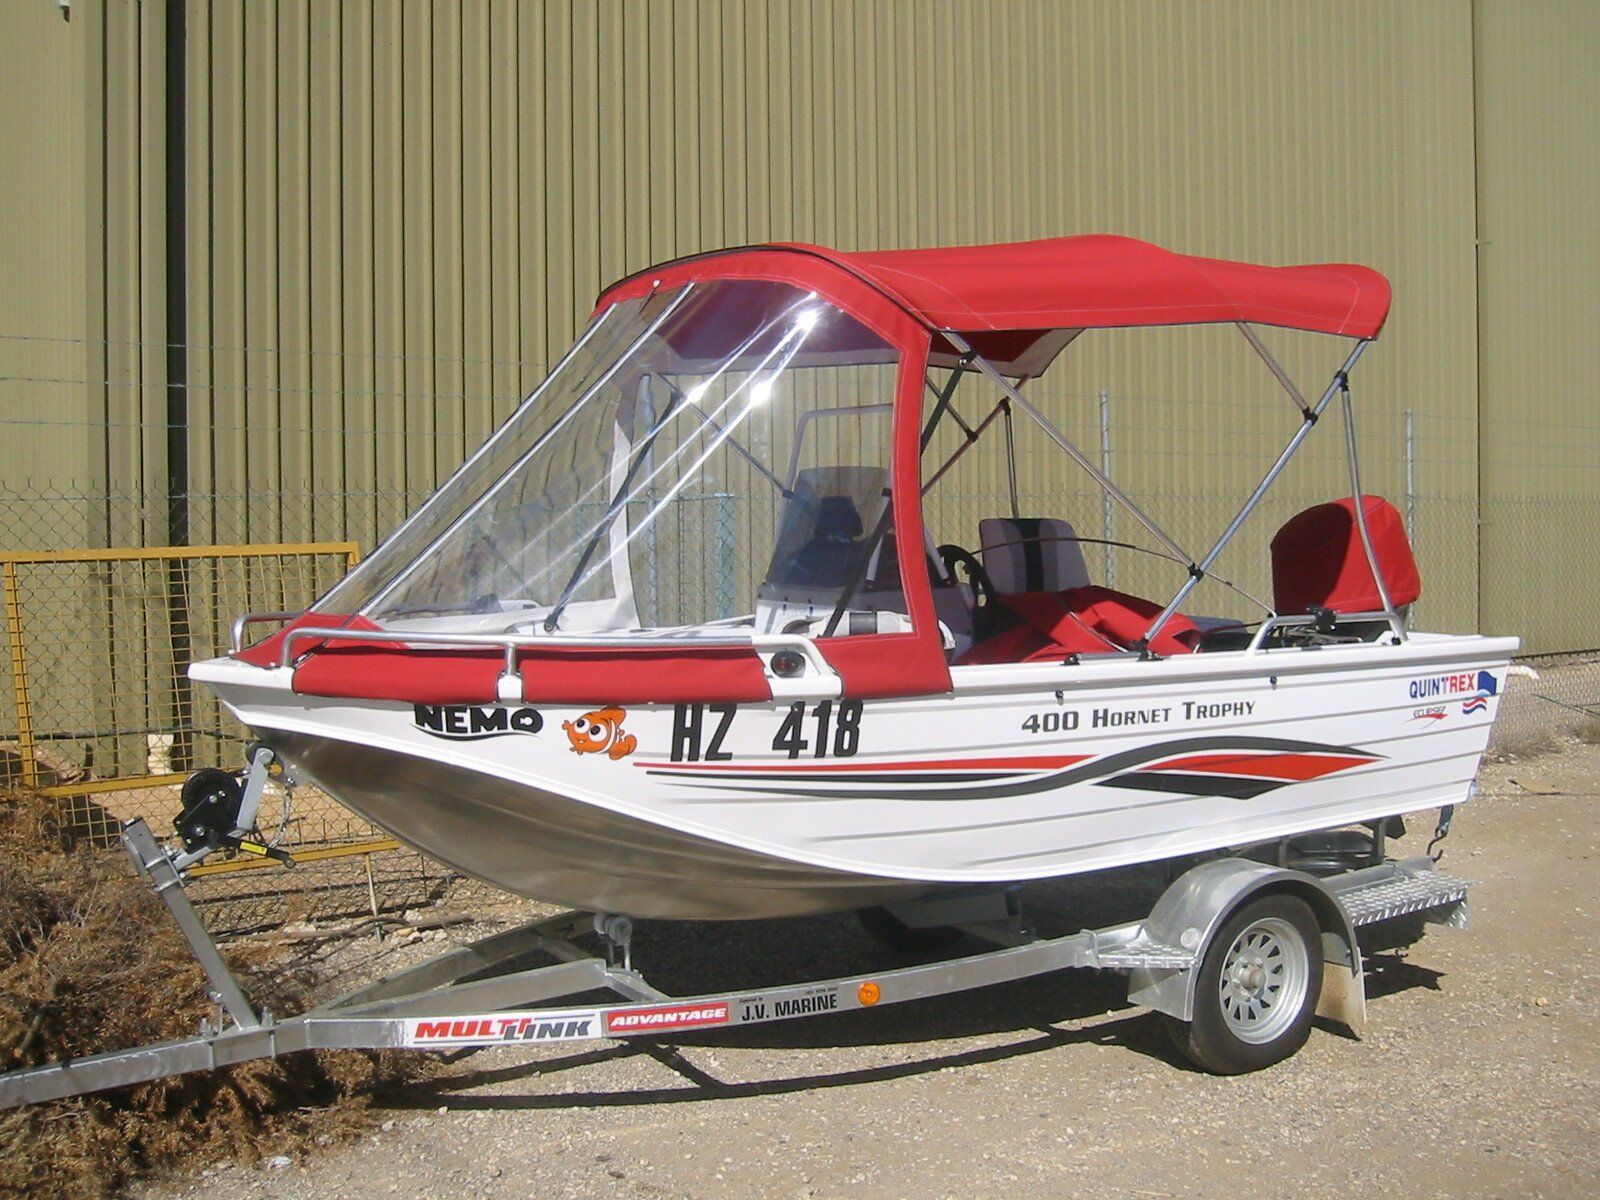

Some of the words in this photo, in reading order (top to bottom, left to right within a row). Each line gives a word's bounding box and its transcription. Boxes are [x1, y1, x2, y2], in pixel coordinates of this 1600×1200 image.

[1410, 673, 1475, 699] QUINTREX
[413, 702, 544, 734] NEMO
[670, 702, 738, 762] HZ
[772, 699, 864, 759] 418
[1021, 710, 1080, 734] 400
[610, 1007, 727, 1027] ADVANTAGE
[741, 1004, 769, 1021] J.V.
[775, 994, 838, 1017] MARINE
